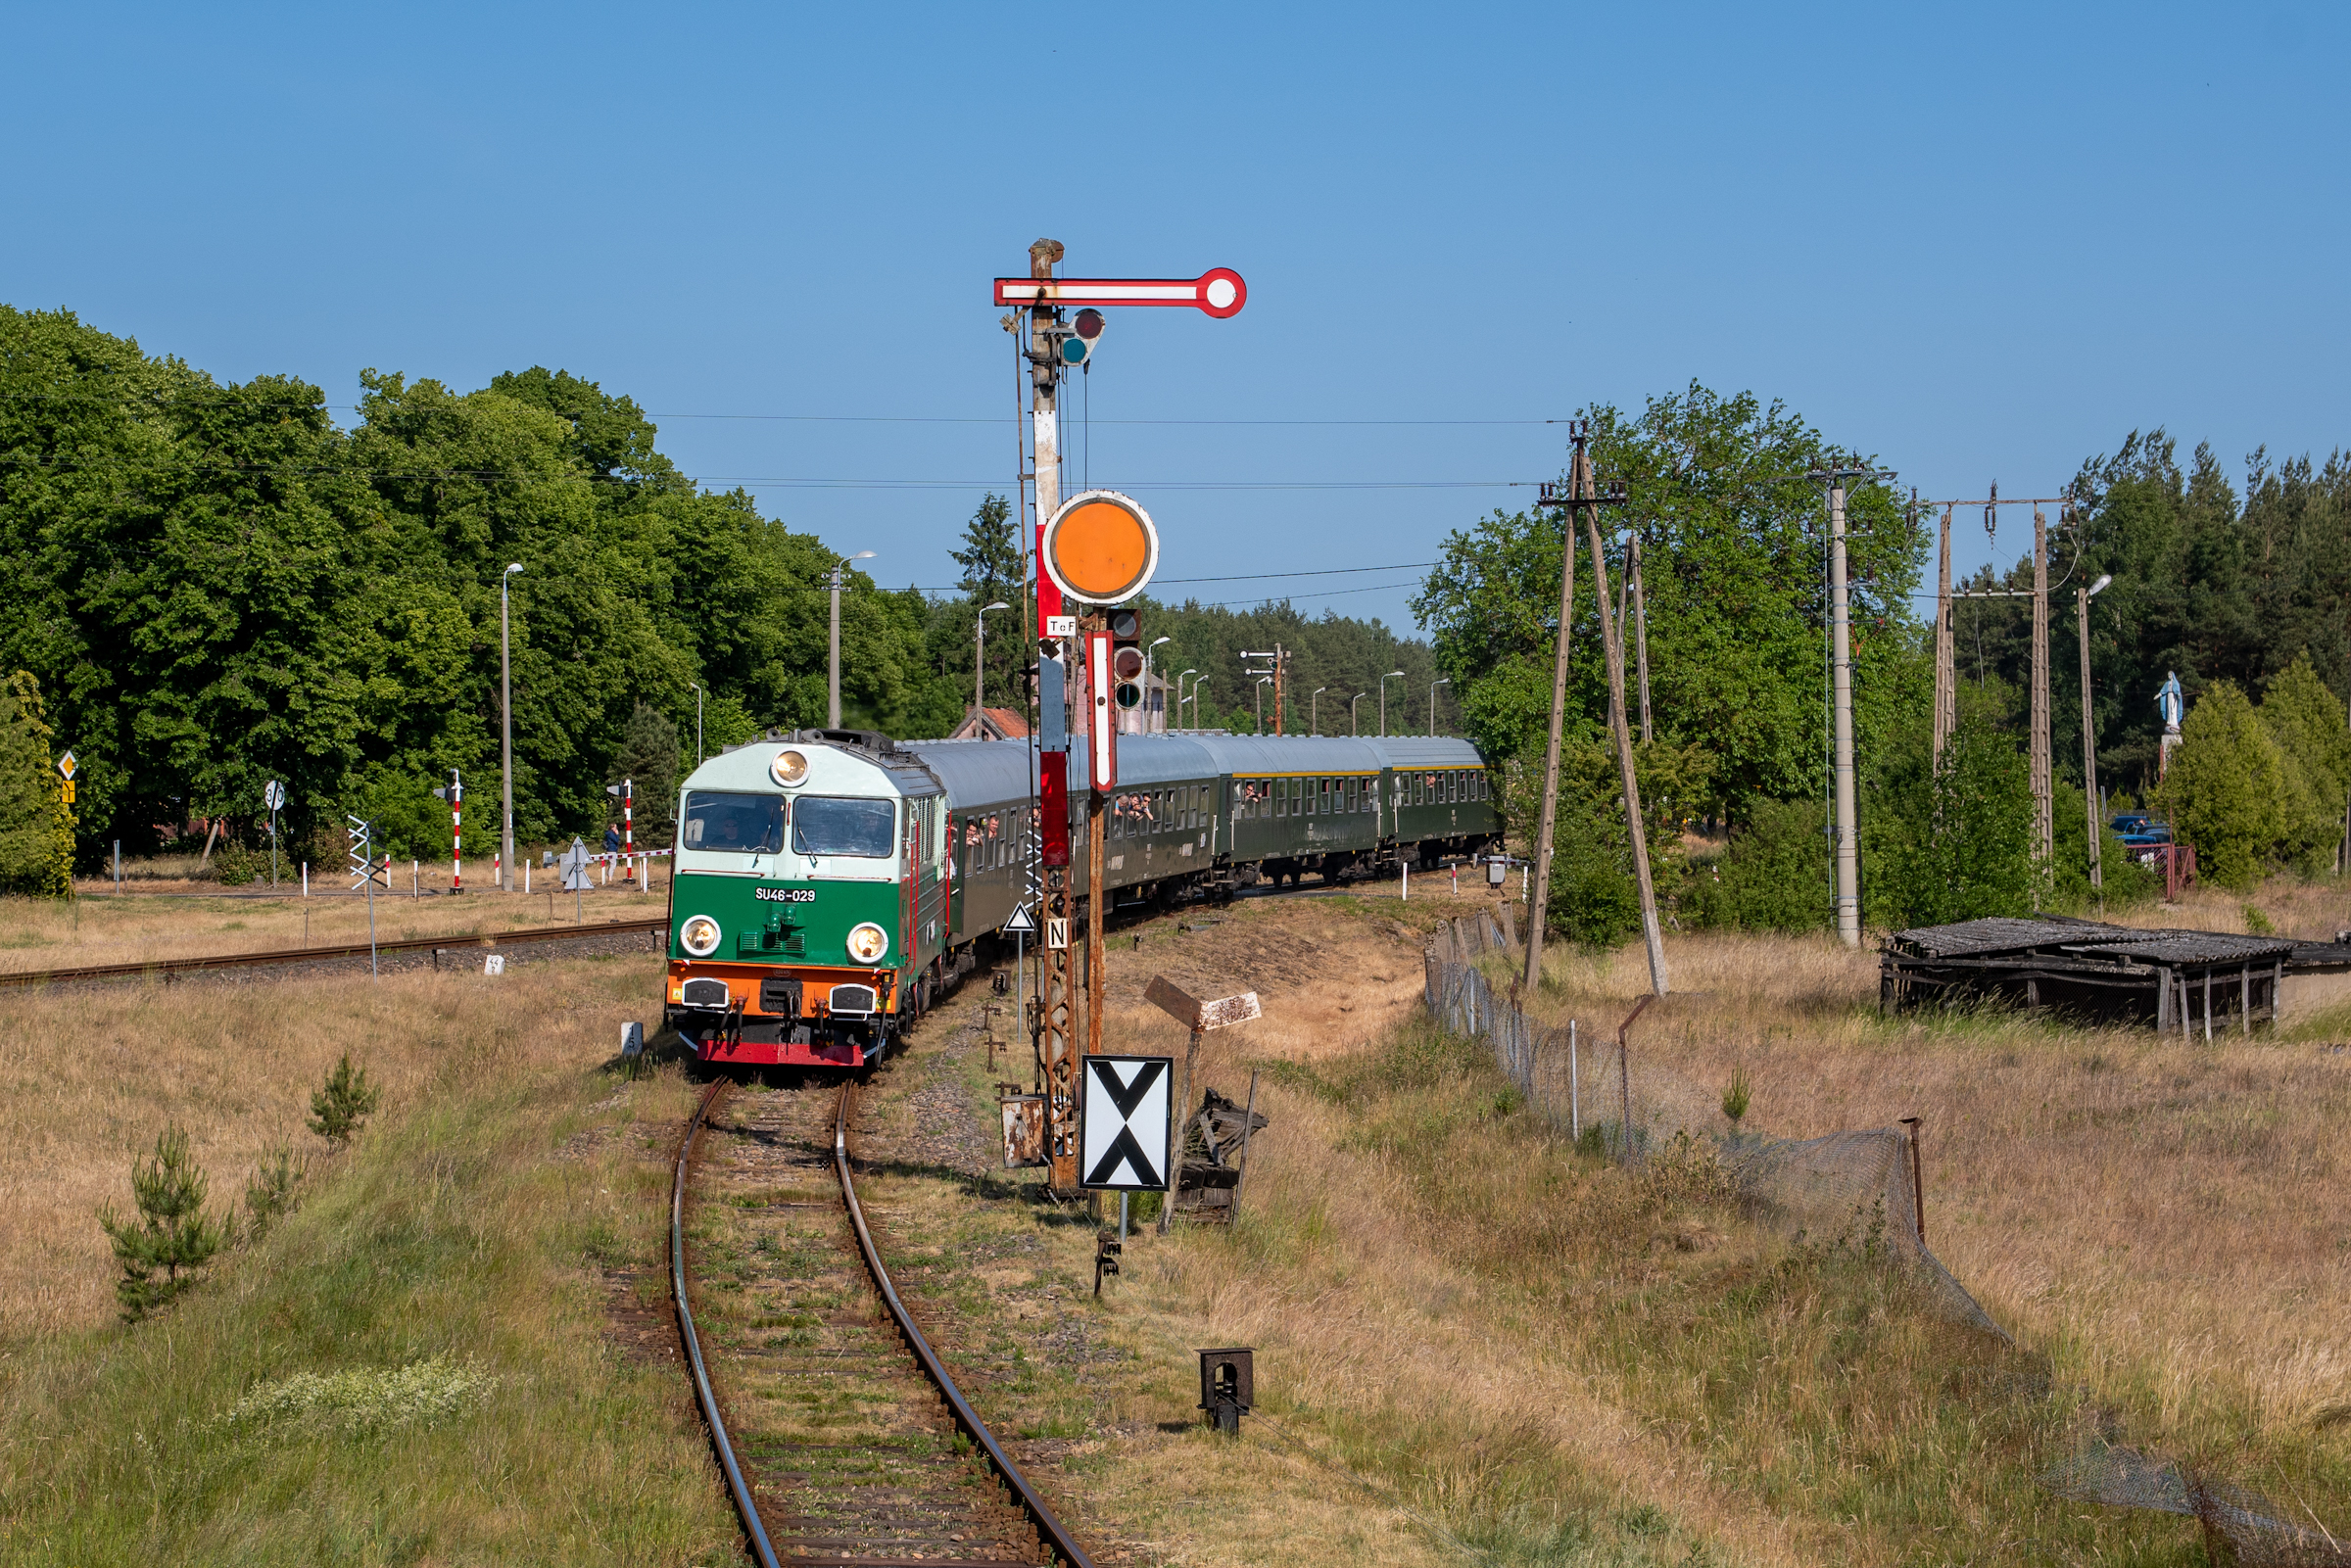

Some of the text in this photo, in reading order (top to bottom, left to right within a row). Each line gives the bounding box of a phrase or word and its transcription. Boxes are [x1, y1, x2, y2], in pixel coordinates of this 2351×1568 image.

[755, 887, 816, 902] SU46-029
[1051, 922, 1064, 946] N
[628, 1037, 635, 1048] 5
